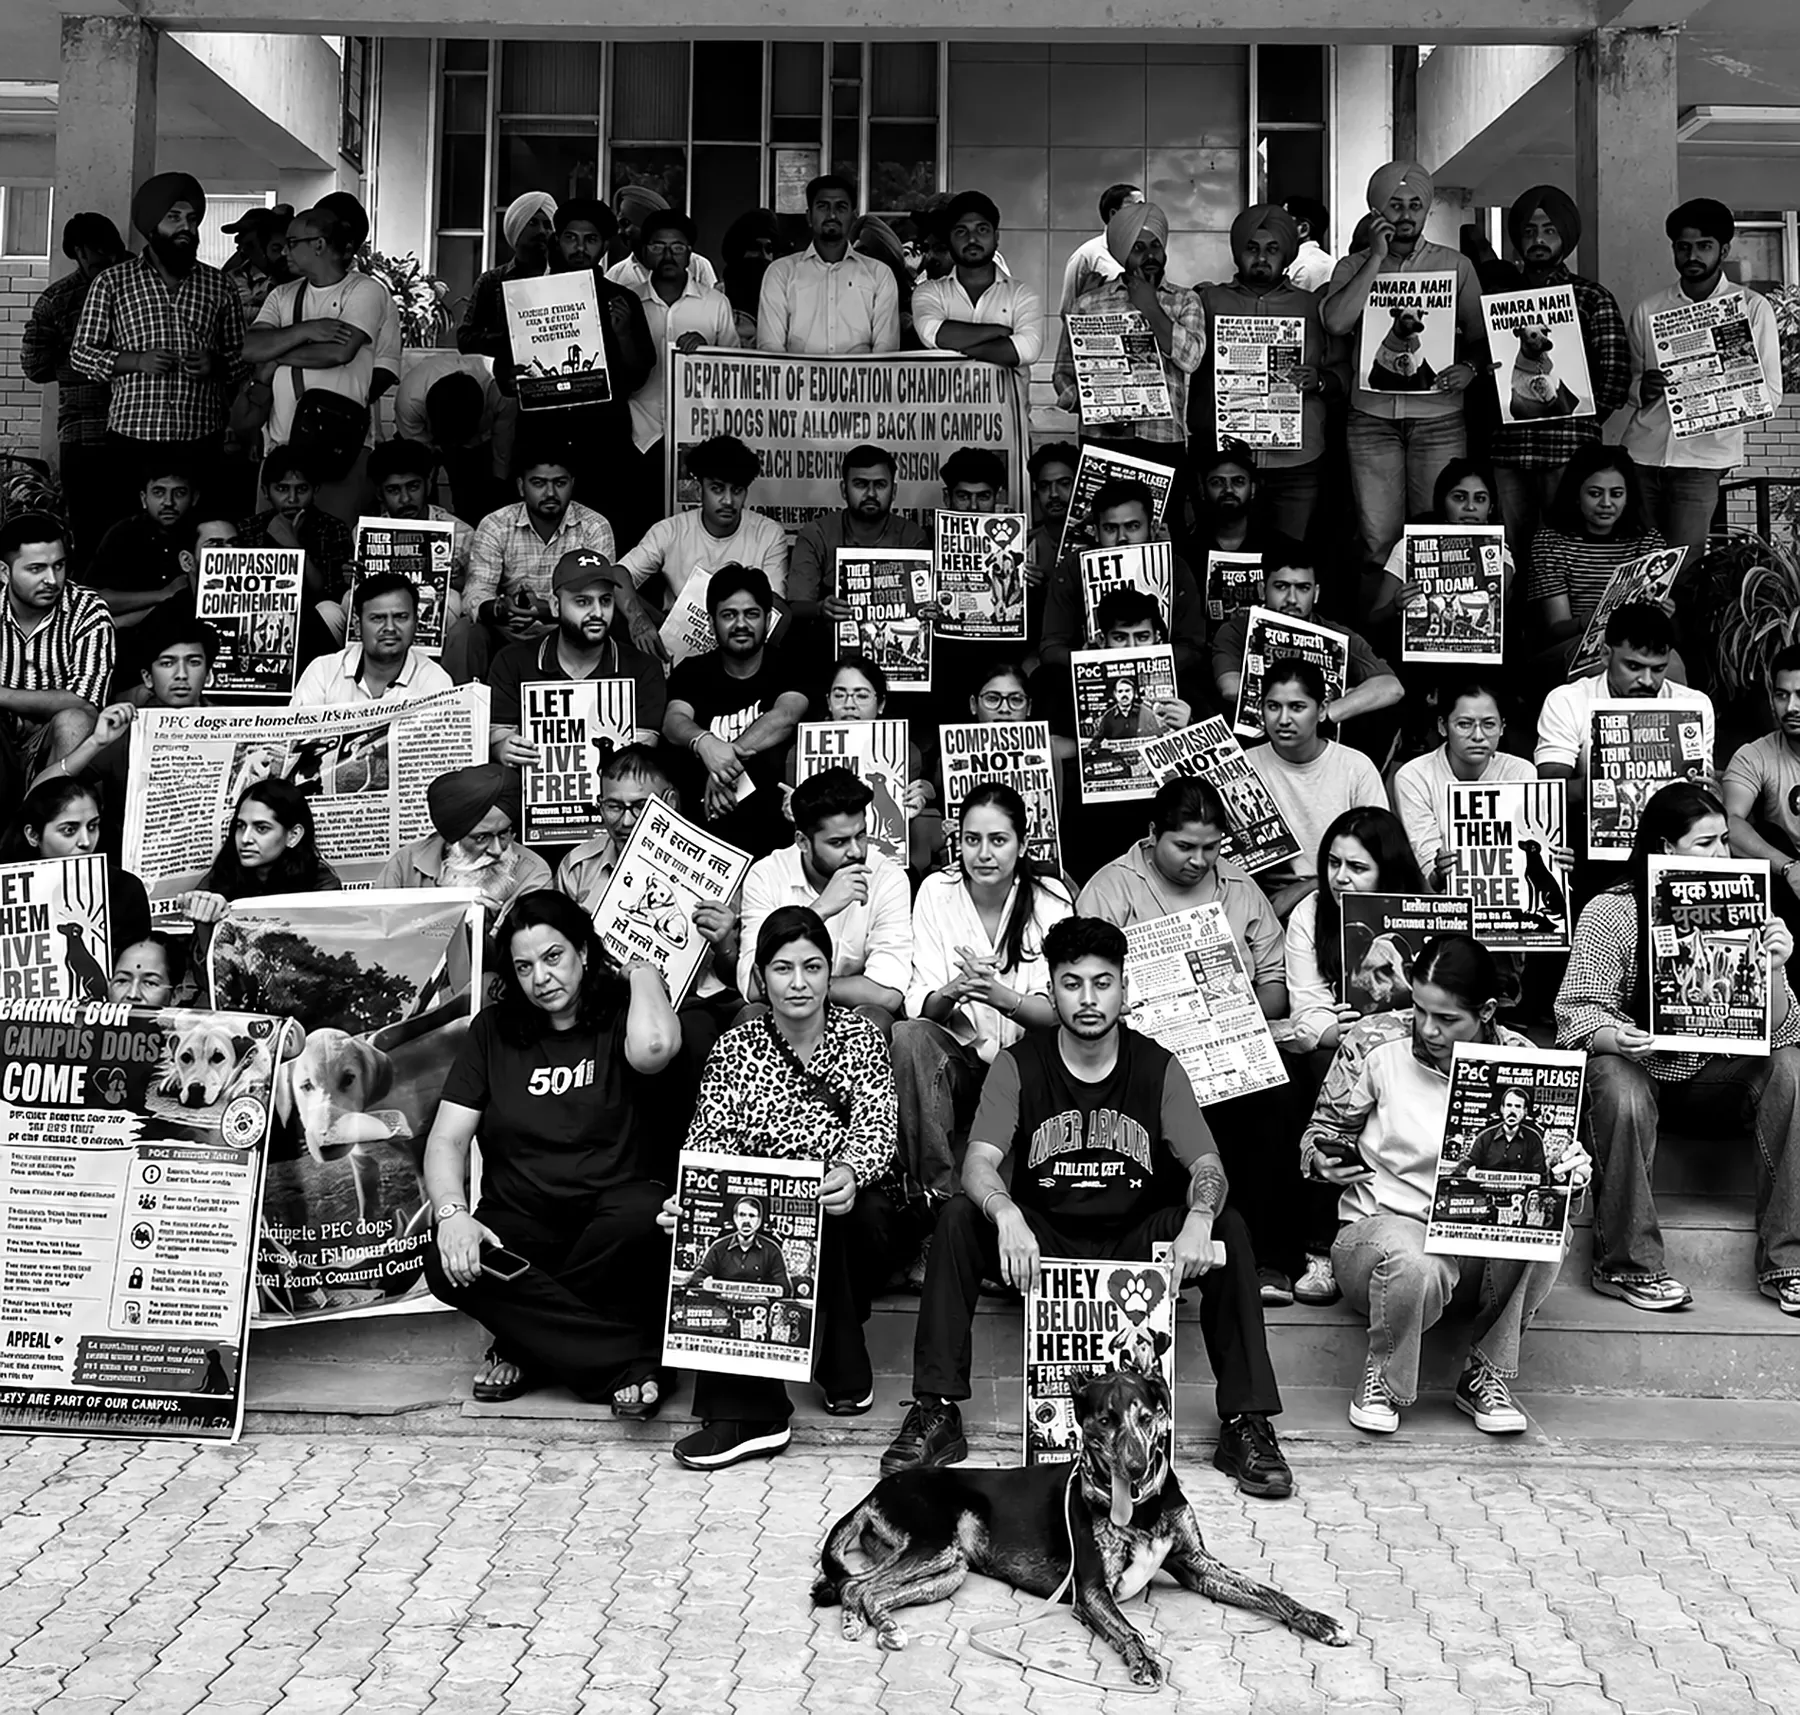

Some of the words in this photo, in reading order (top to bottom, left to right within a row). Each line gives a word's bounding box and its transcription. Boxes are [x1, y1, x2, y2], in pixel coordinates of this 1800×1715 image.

[1369, 280, 1416, 294] AWARA
[1369, 295, 1422, 308] HUMARA
[1426, 295, 1452, 308] HAI!
[1490, 298, 1535, 316] AWARA
[1538, 293, 1571, 311] NAHI
[1547, 309, 1574, 325] HAI!
[684, 361, 782, 400] DEPARTMENT
[786, 365, 805, 400] OF
[809, 366, 893, 402] EDUCATION
[899, 366, 992, 403] CHANDIGARH
[723, 408, 764, 438] DOGS
[768, 408, 797, 438] NOT
[802, 410, 872, 440] ALLOWED
[877, 412, 917, 440] BACK
[921, 412, 936, 441] IN
[940, 412, 1003, 442] CAMPUS
[941, 516, 979, 535] THEY
[204, 553, 299, 576] COMPASSION
[941, 553, 983, 571] HERE
[1086, 554, 1124, 583] LET
[224, 575, 278, 592] NOT
[529, 689, 574, 718] LET
[194, 716, 228, 731] dogs
[229, 716, 252, 728] are
[530, 719, 586, 745] THEM
[804, 729, 850, 755] LET
[945, 725, 1047, 755] COMPASSION
[1144, 719, 1232, 770] COMPASSION
[970, 751, 1025, 773] NOT
[1174, 747, 1221, 777] NOT
[1600, 762, 1621, 780] TO
[530, 773, 593, 803] FREE
[1453, 790, 1501, 820] LET
[1453, 820, 1512, 847] THEM
[1456, 847, 1513, 877] LIVE
[1455, 877, 1520, 907] FREE
[4, 1025, 94, 1060] CAMPUS
[100, 1030, 160, 1062] DOGS
[2, 1061, 88, 1105] COME
[527, 1058, 587, 1096] 501
[1535, 1068, 1580, 1088] PLEASE
[321, 1223, 353, 1241] PEC
[356, 1218, 393, 1238] dogs
[1041, 1267, 1100, 1299] THEY
[1036, 1300, 1119, 1332] BELONG
[6, 1331, 51, 1349] APPEAL
[1036, 1333, 1105, 1362] HERE
[27, 1393, 50, 1406] ARE
[54, 1394, 85, 1407] PART
[86, 1396, 102, 1408] OF
[104, 1397, 128, 1410] OUR
[131, 1398, 182, 1412] CAMPUS.
